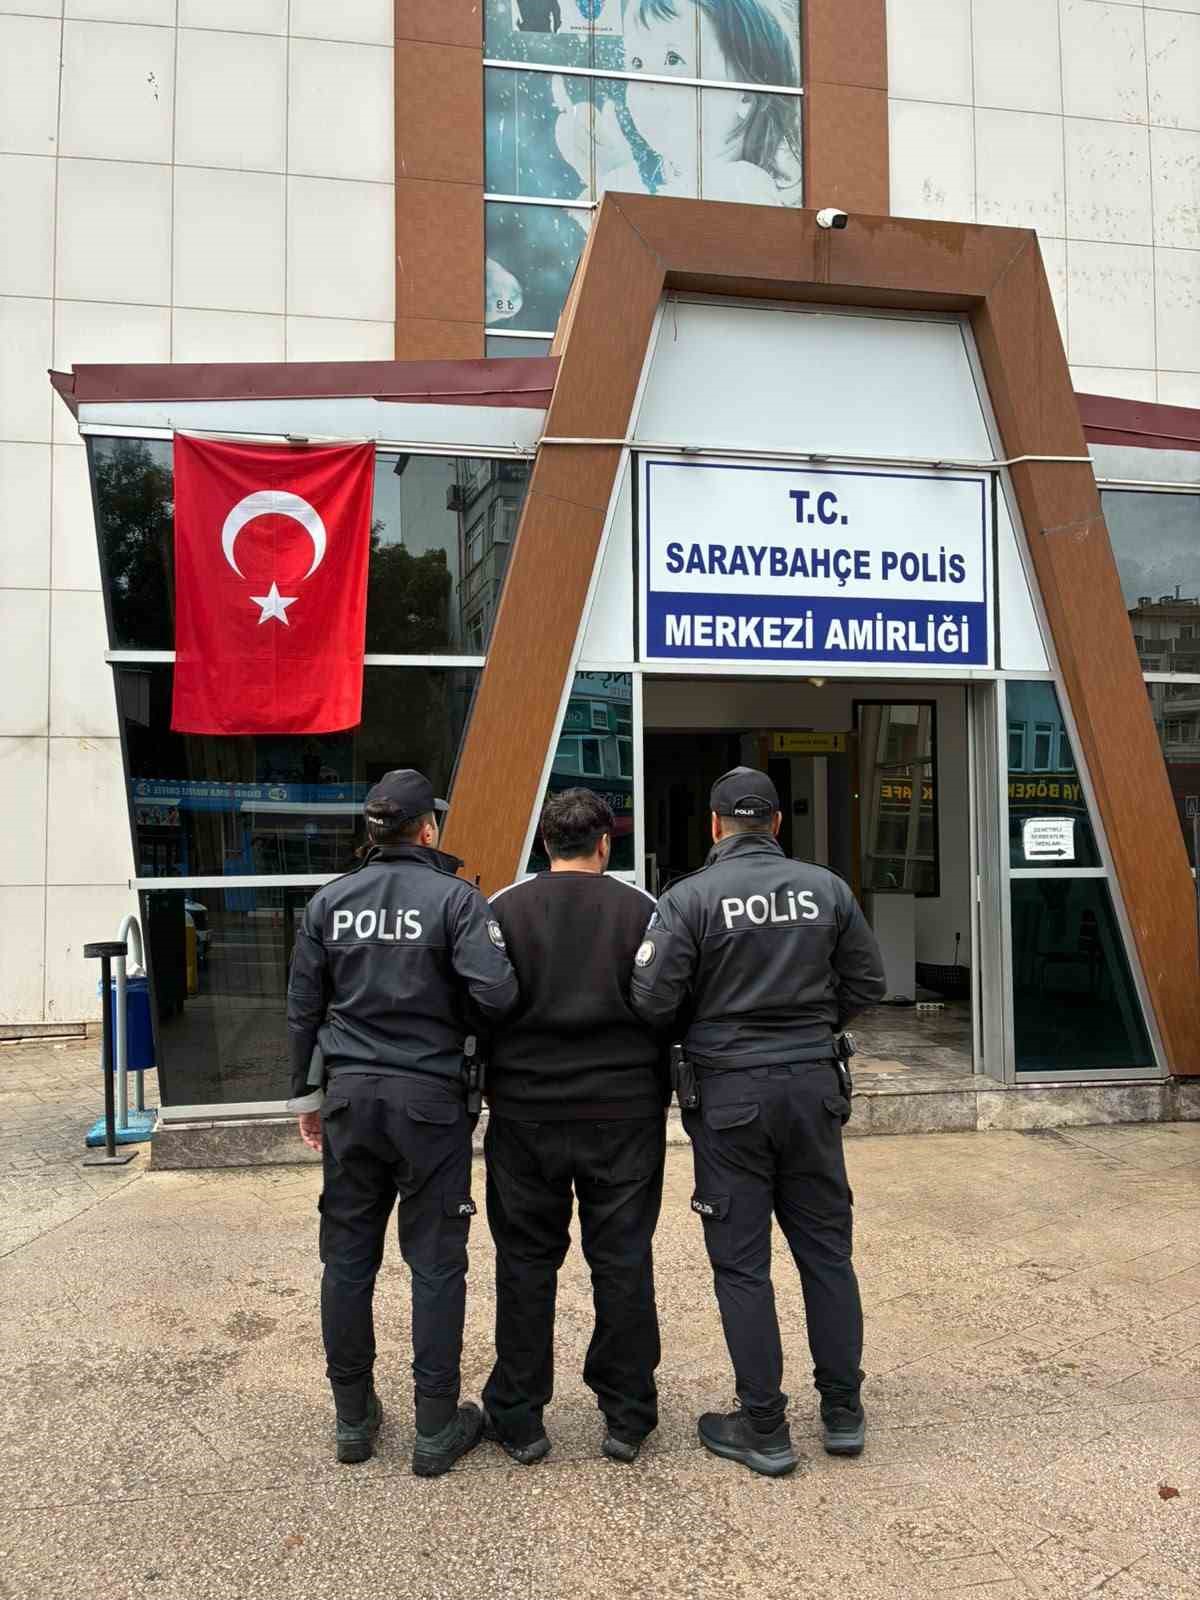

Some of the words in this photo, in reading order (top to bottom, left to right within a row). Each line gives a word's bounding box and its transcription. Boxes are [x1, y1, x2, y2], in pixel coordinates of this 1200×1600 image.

[789, 489, 848, 525] T.C.
[665, 542, 871, 586] SARAYBAHÇE
[881, 546, 966, 584] POLİS
[665, 610, 814, 649] MERKEZİ
[824, 612, 970, 653] AMİRLİĞİ
